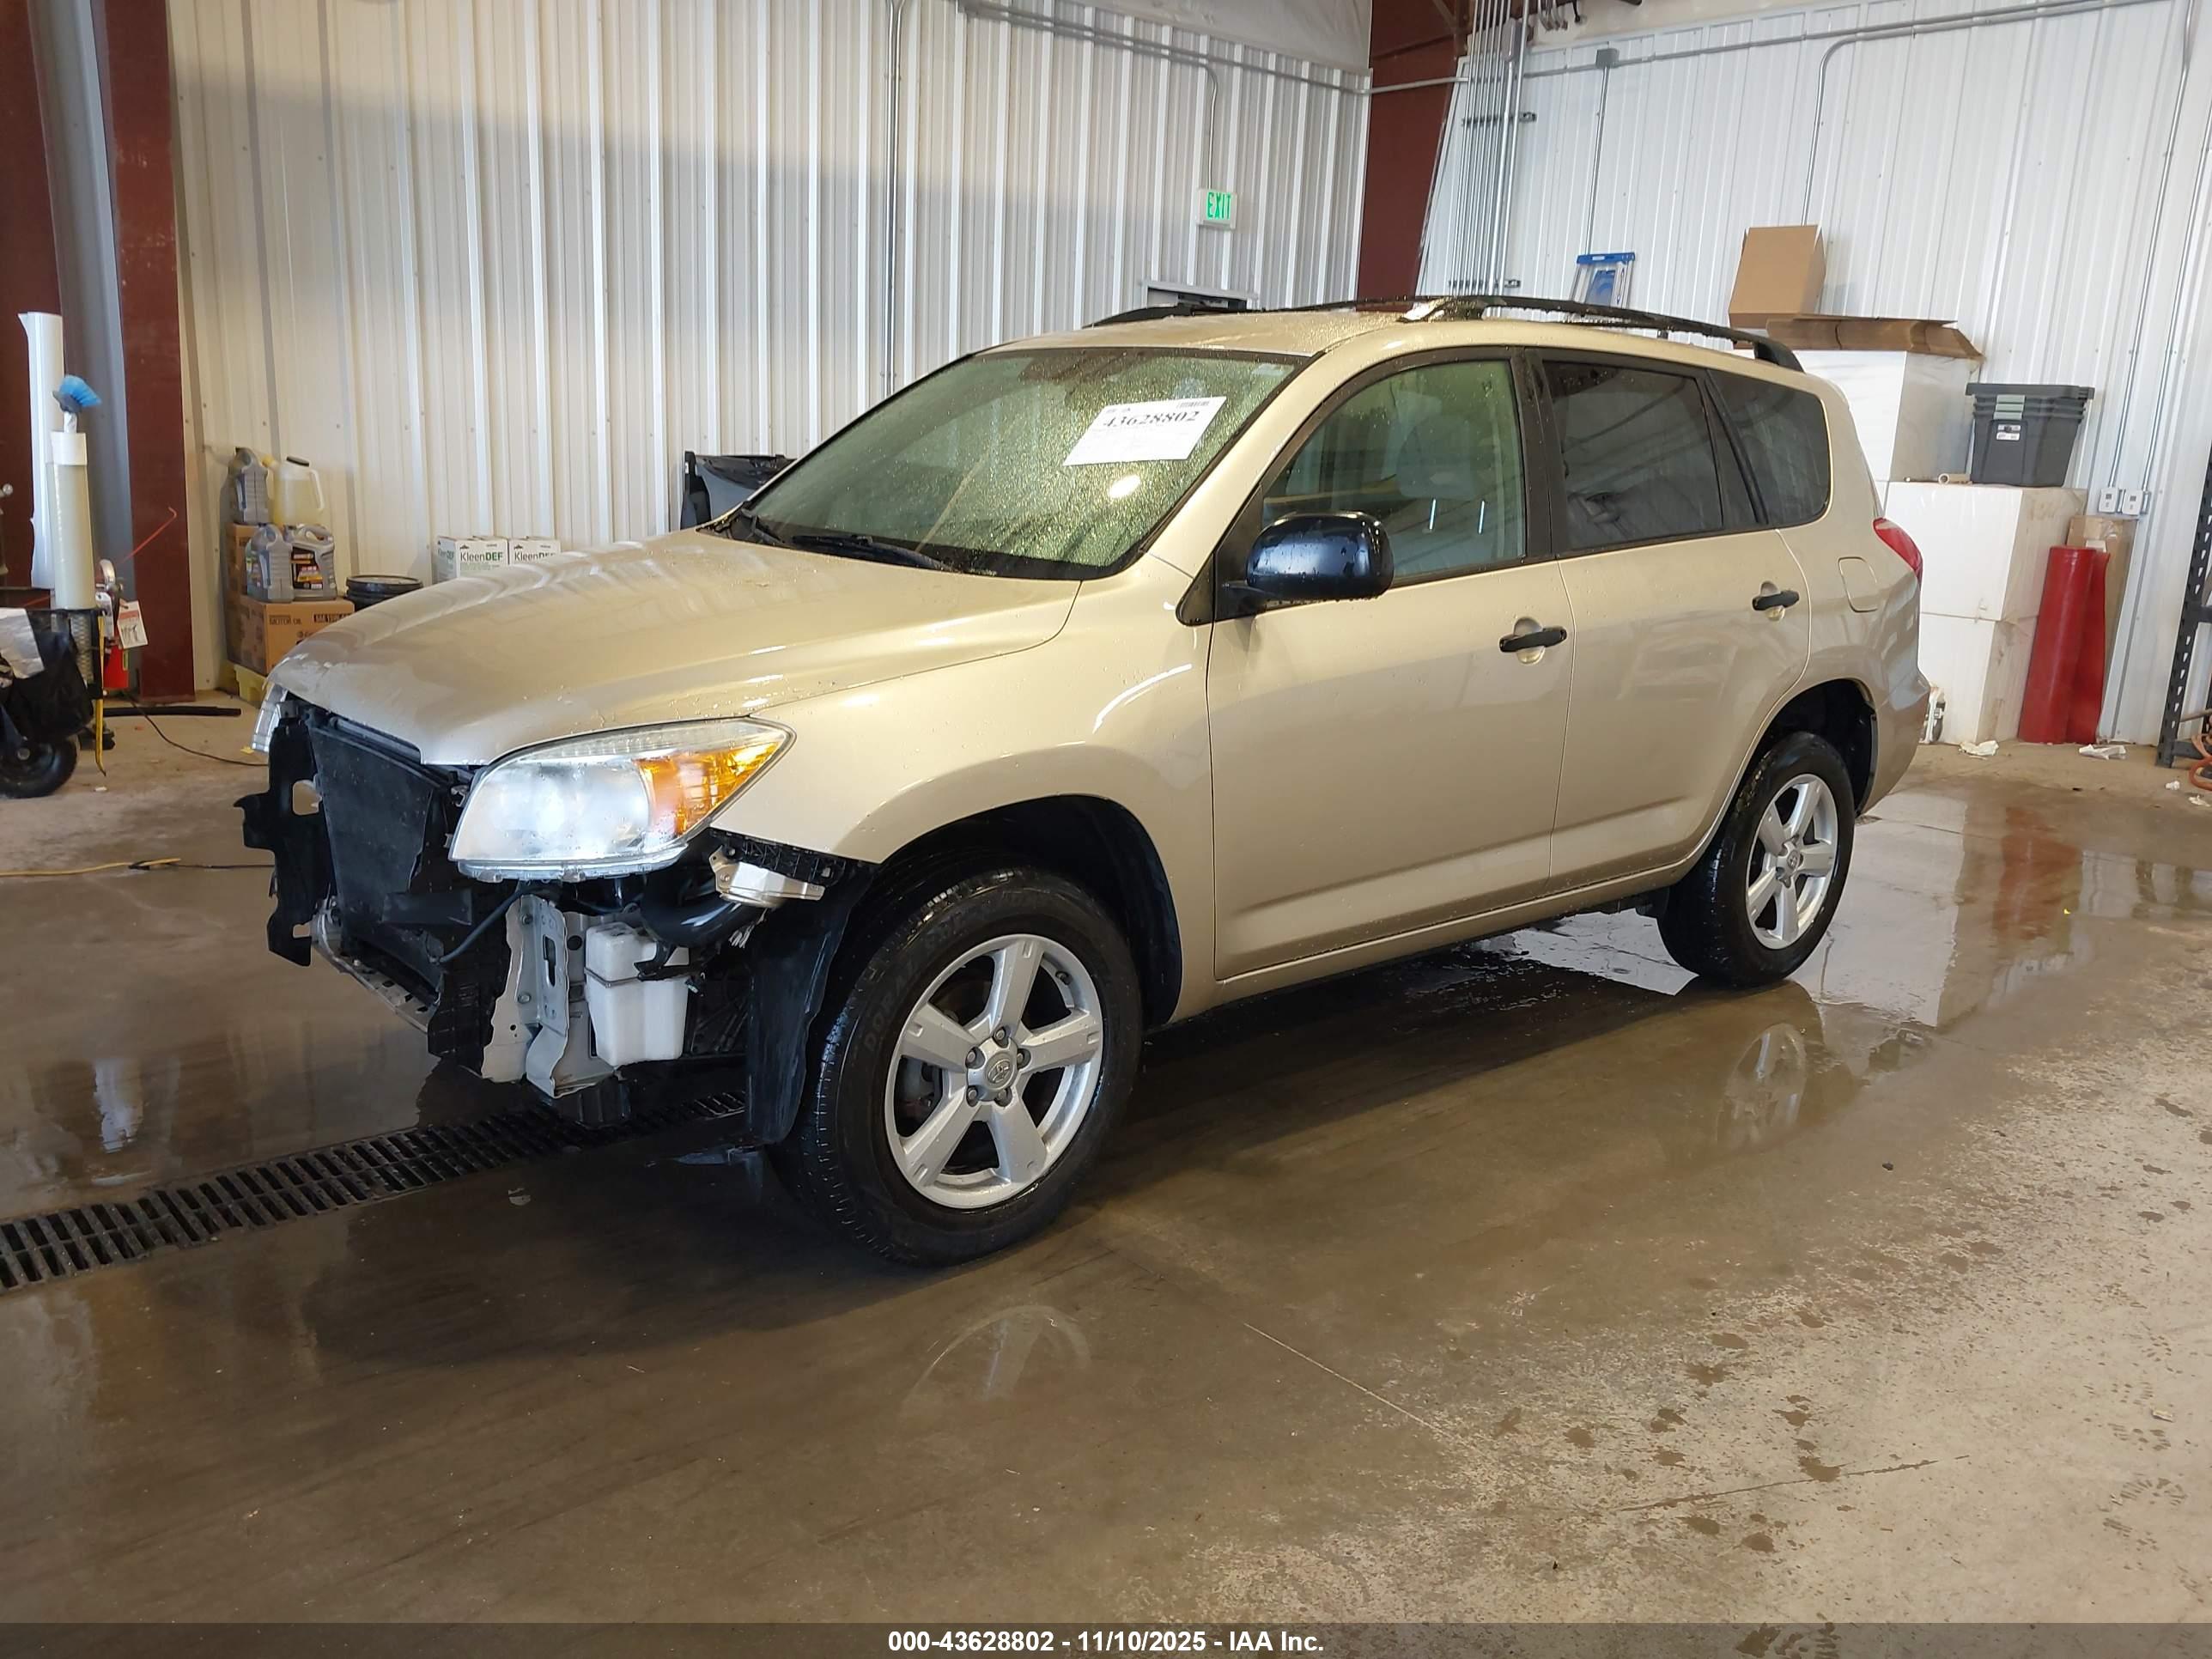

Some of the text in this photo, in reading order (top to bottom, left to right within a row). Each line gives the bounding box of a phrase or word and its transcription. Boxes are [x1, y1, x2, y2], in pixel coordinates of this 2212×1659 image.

[1207, 191, 1231, 219] EXIT
[1103, 410, 1200, 428] 43628802
[460, 551, 503, 562] KleenDEF
